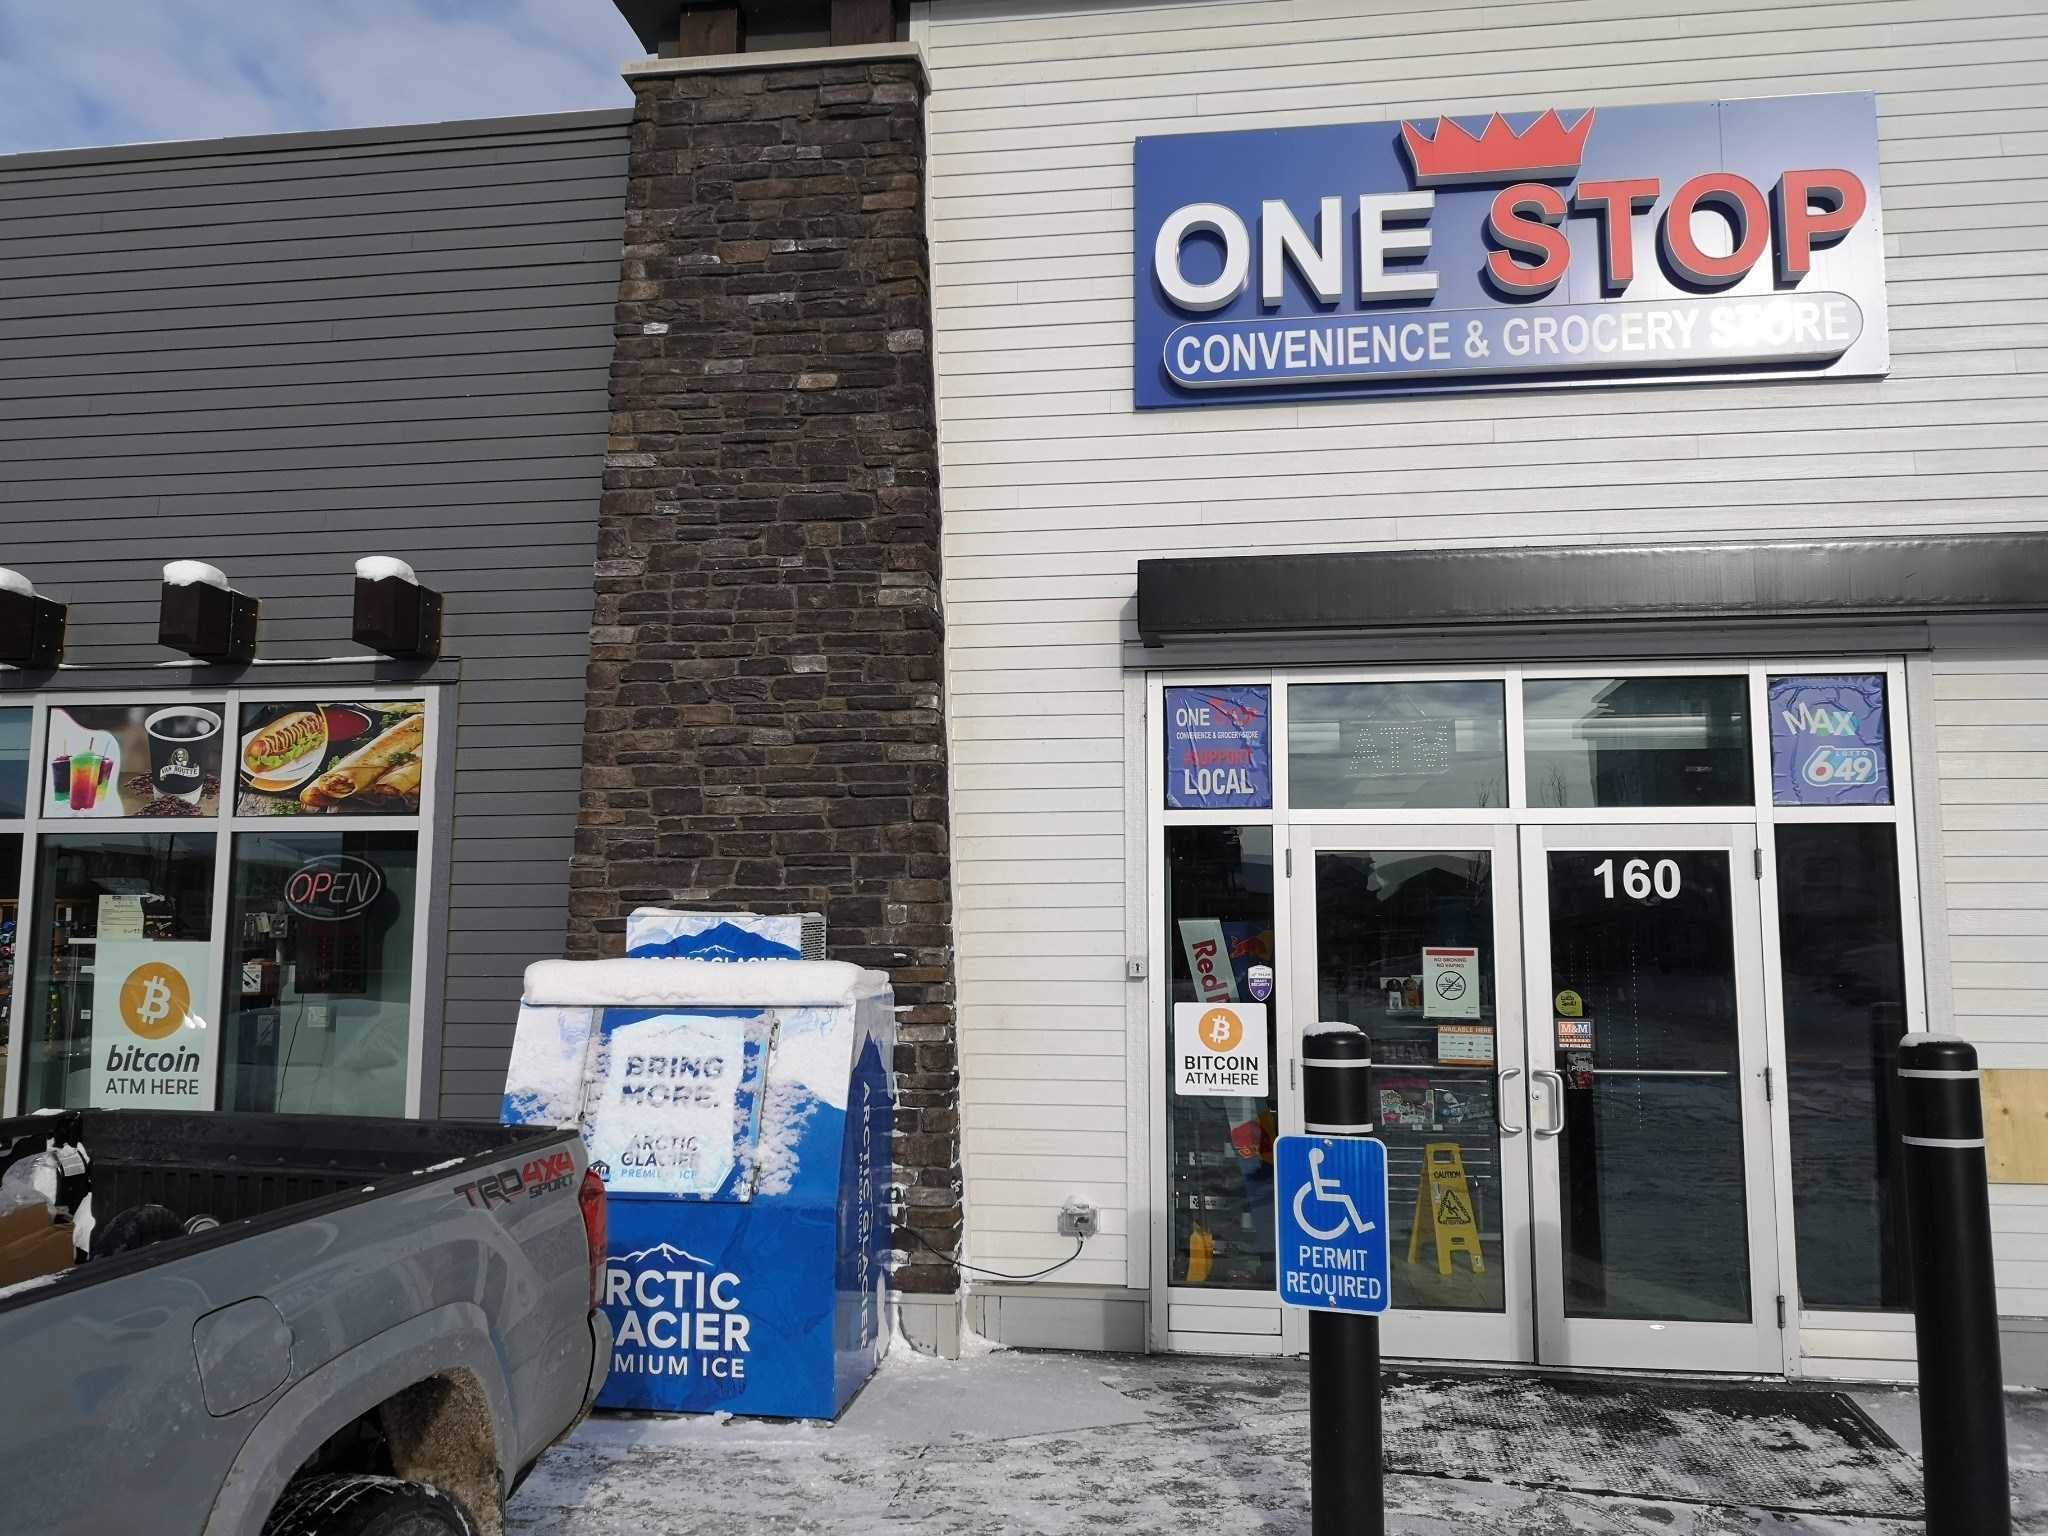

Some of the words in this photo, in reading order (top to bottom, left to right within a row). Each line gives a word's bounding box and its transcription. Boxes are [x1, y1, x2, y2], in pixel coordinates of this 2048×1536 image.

[1154, 190, 1440, 311] ONE
[1487, 168, 1867, 296] STOP
[1176, 322, 1451, 376] CONVENIENCE
[1464, 320, 1491, 360] &
[1502, 306, 1699, 355] GROCERY
[1708, 300, 1849, 347] STORE
[1176, 708, 1210, 727] ONE
[1782, 702, 1856, 736] MAX
[1808, 750, 1873, 782] 649
[1184, 768, 1255, 795] LOCAL
[290, 872, 372, 904] OPEN
[1594, 859, 1681, 899] 160
[1192, 938, 1228, 993] Red
[1561, 1023, 1589, 1034] M&M
[106, 1044, 200, 1073] bitcoin
[626, 1056, 724, 1078] BRING
[1185, 1056, 1259, 1071] BITCOIN
[106, 1078, 145, 1094] ATM
[151, 1079, 199, 1095] HERE
[1185, 1072, 1217, 1085] ATM
[1221, 1073, 1259, 1086] HERE
[862, 1080, 871, 1202] ARCTIC
[529, 1173, 574, 1199] SPORT
[1433, 1170, 1461, 1179] CAUTION
[454, 1168, 526, 1211] TRD
[1299, 1245, 1368, 1272] PERMIT
[606, 1268, 741, 1311] RCTIC
[860, 1209, 870, 1351] GLACIER
[1286, 1271, 1382, 1300] REQUIRED
[613, 1310, 751, 1352] ACIER
[612, 1353, 688, 1376] MIUM
[702, 1357, 745, 1378] ICE
